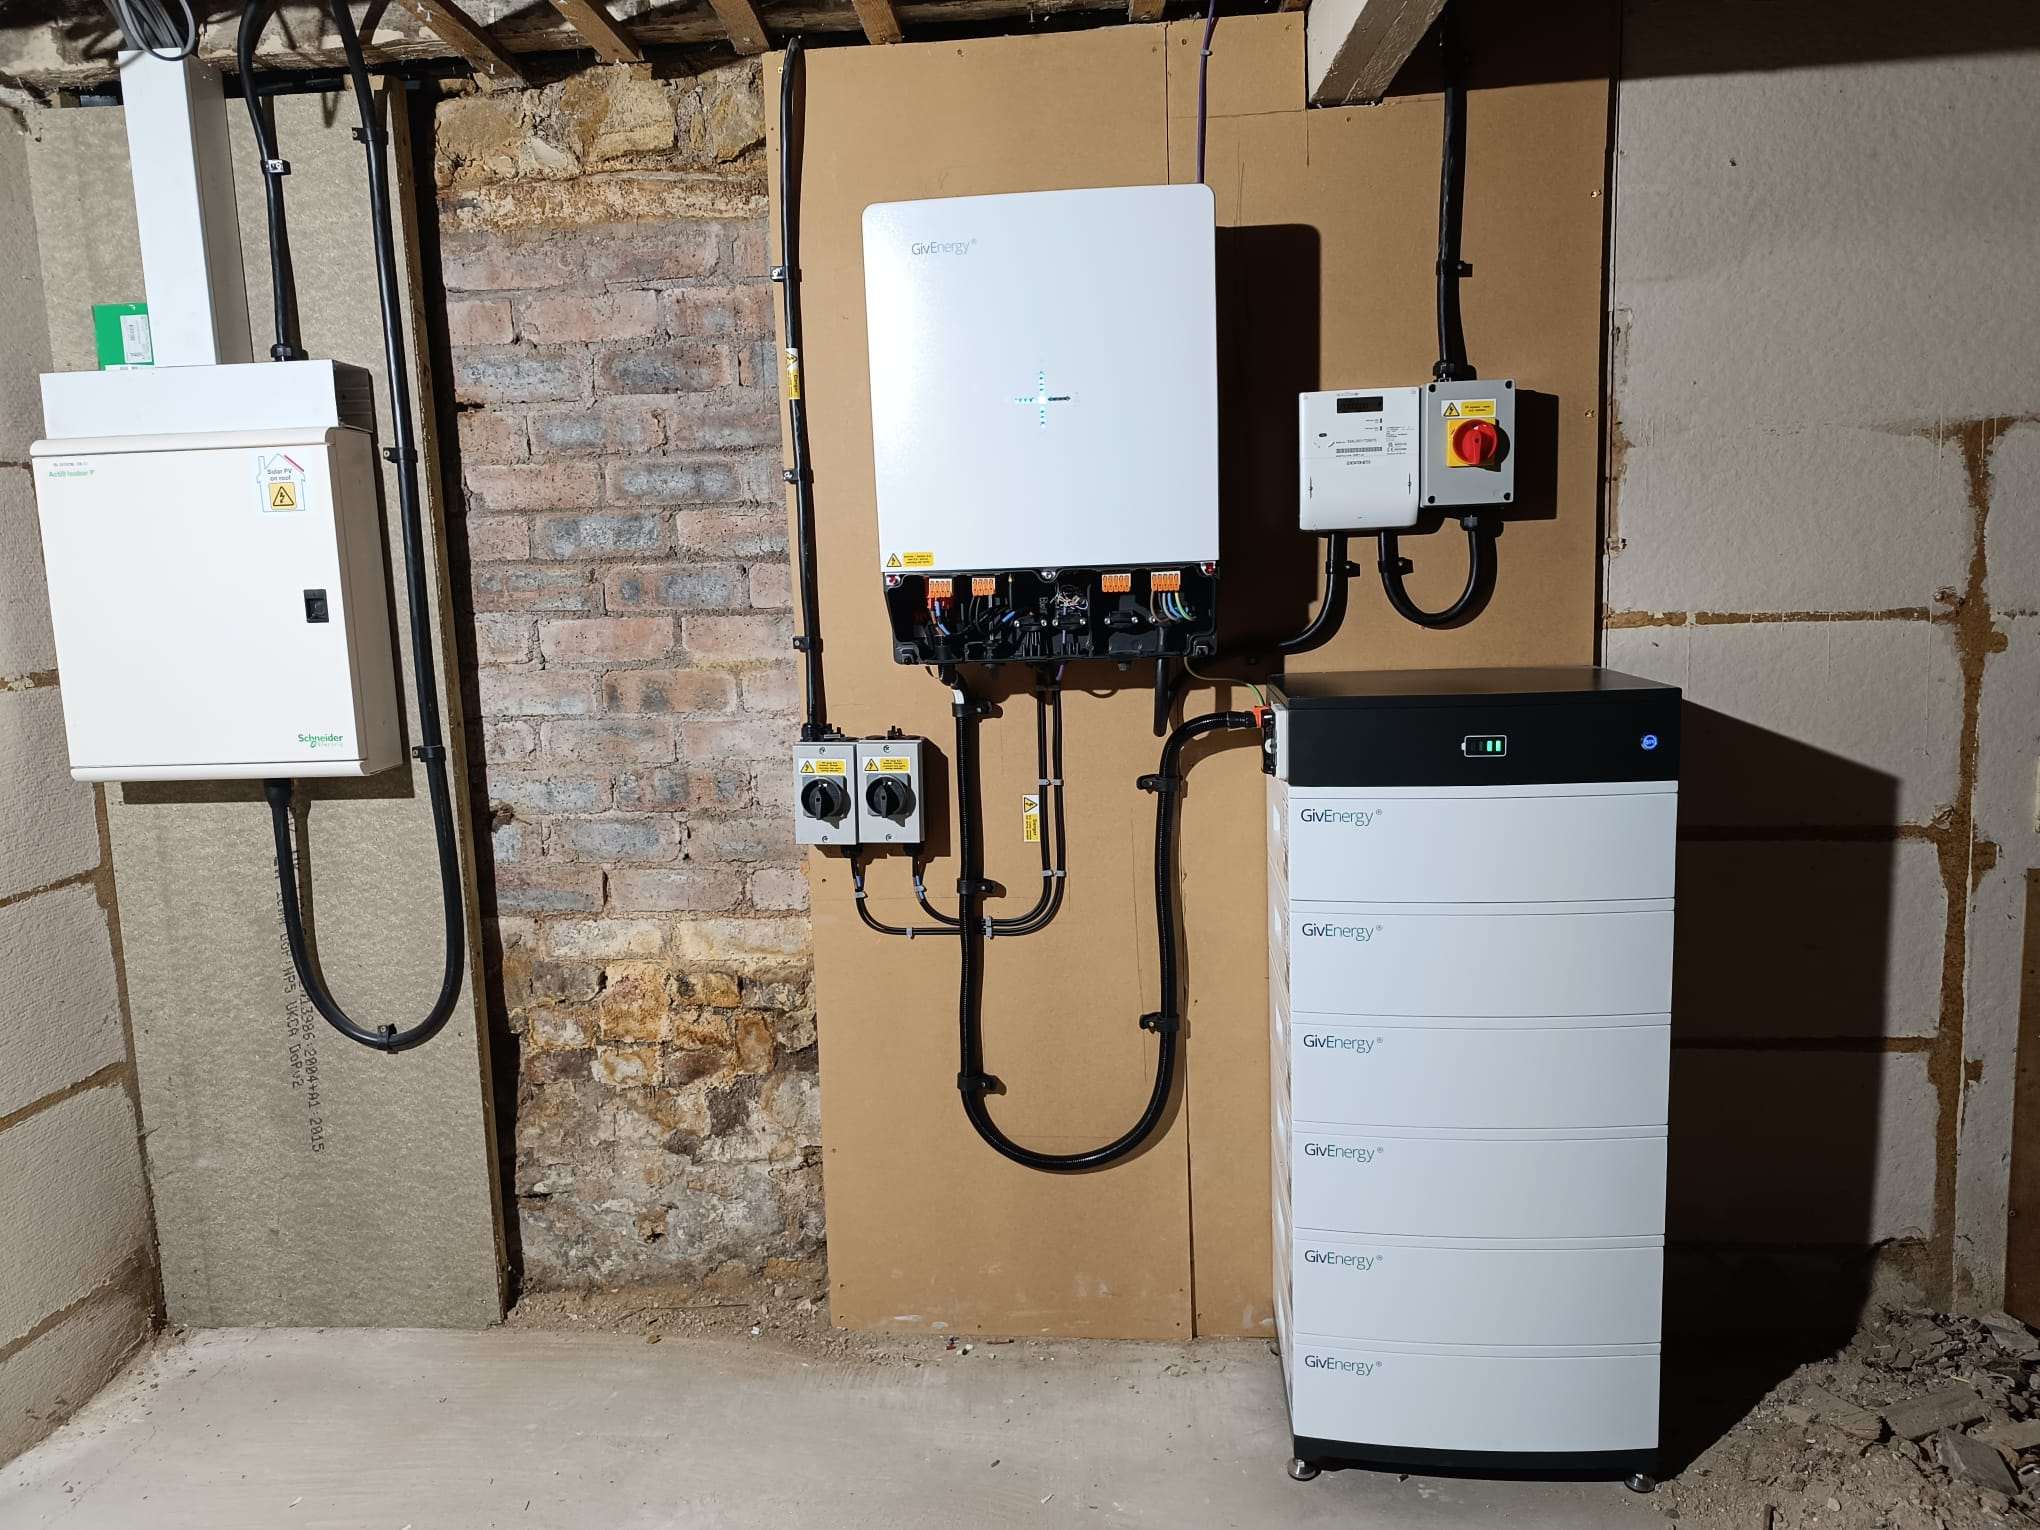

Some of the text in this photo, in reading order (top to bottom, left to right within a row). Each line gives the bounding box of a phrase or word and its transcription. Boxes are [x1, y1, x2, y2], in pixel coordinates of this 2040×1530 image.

[297, 733, 343, 748] Schneider
[1301, 808, 1374, 827] GivEnergy
[1302, 922, 1375, 942] GivEnergy
[285, 1001, 299, 1038] UKCA
[1303, 1034, 1375, 1054] GivEnergy
[1304, 1143, 1375, 1165] GivEnergy
[1304, 1249, 1375, 1272] GivEnergy
[1304, 1355, 1374, 1377] GivEnergy
